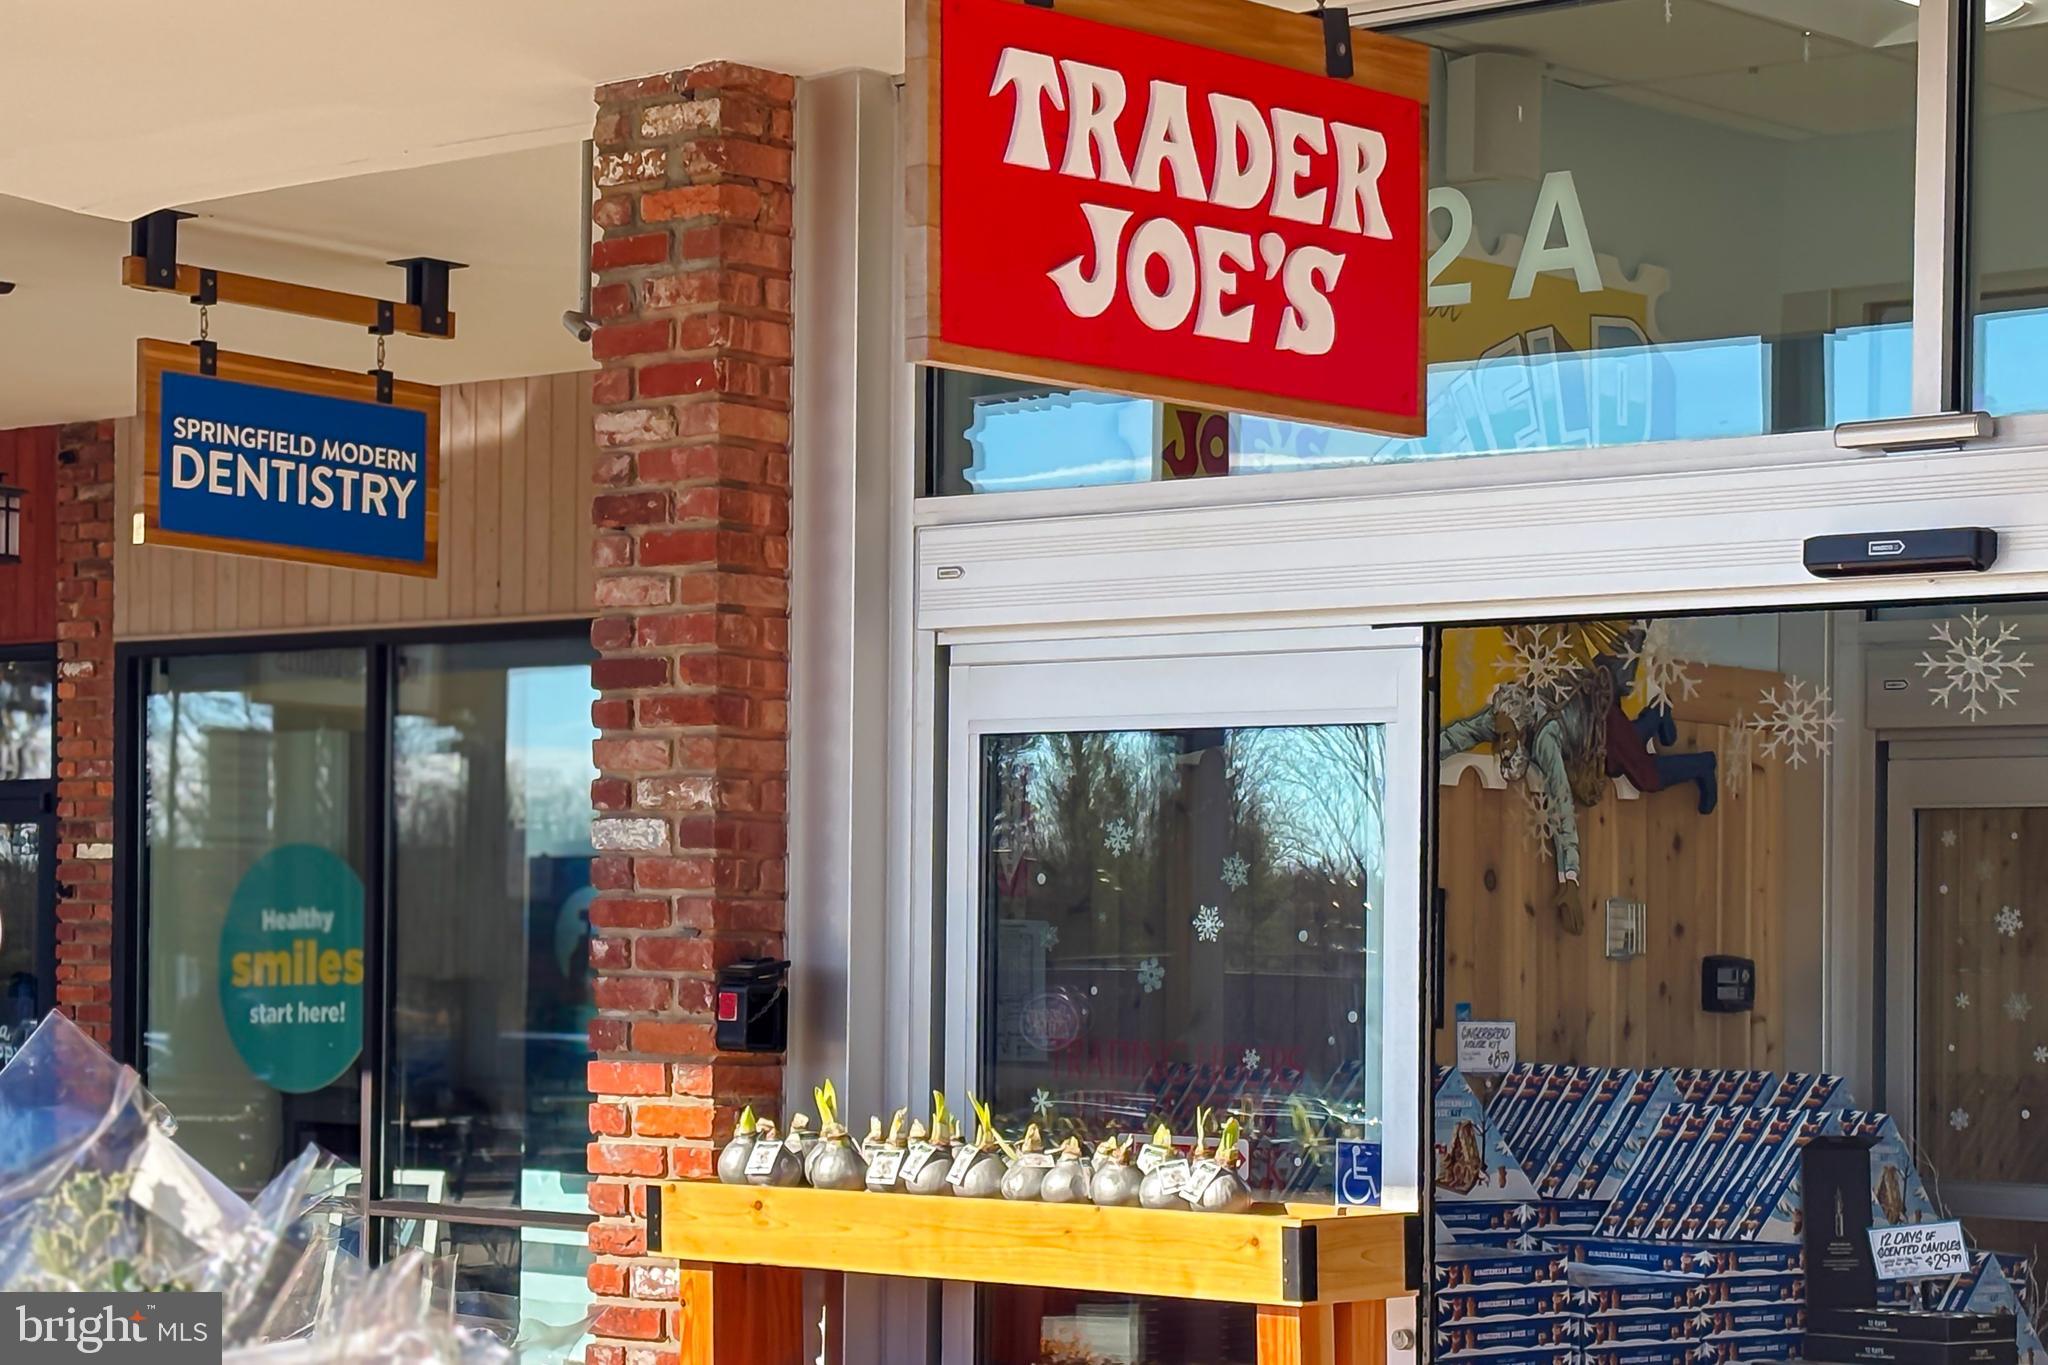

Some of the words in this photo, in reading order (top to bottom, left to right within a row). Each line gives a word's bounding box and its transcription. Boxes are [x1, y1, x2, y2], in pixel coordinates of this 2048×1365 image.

[989, 46, 1395, 241] TRADER
[1508, 170, 1604, 300] A
[1048, 202, 1347, 356] JOE'S
[173, 416, 317, 457] SPRINGFIELD
[321, 439, 418, 473] MODERN
[171, 445, 418, 520] DENTISTRY
[261, 907, 335, 936] Healthy
[230, 940, 365, 989] smiles
[249, 1002, 294, 1025] start
[297, 1001, 346, 1025] here!
[1488, 1040, 1501, 1050] KIT
[1877, 1244, 1920, 1259] SCENTED
[1920, 1239, 1961, 1254] CANDLES
[1880, 1232, 1892, 1247] 12
[1894, 1229, 1923, 1245] DAYS
[1925, 1231, 1937, 1242] OF
